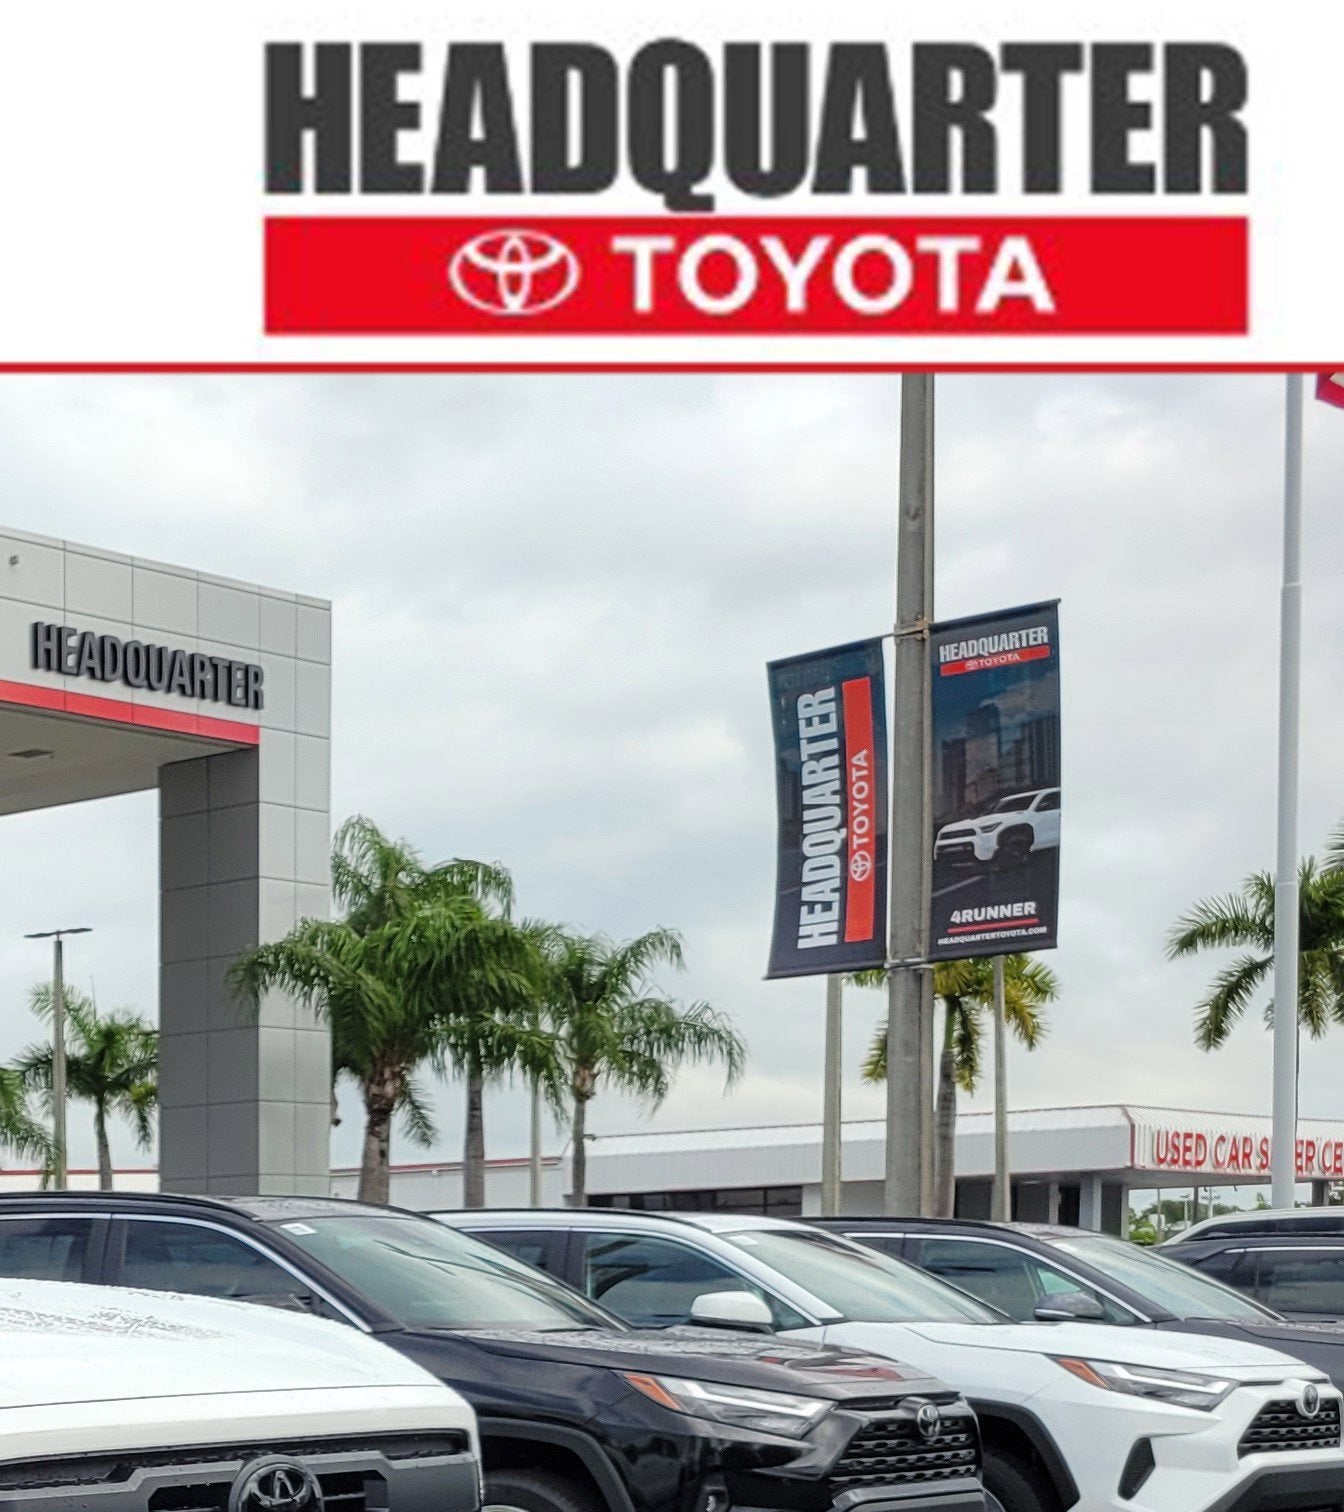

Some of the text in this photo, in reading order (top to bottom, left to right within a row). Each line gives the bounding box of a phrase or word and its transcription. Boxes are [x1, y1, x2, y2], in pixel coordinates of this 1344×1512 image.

[938, 625, 1049, 663] HEADQUARTER
[978, 652, 1021, 667] TOYOTA
[31, 621, 265, 709] HEADQUARTER
[796, 685, 847, 949] HEADQUARTER
[851, 749, 871, 848] TOYOTA
[949, 901, 1037, 924] 4RUNNER
[937, 926, 1048, 945] HEADQUARTERTOYOTA.COM
[1156, 1130, 1208, 1167] USED
[1214, 1134, 1254, 1172] CAR
[1259, 1136, 1316, 1173] SER
